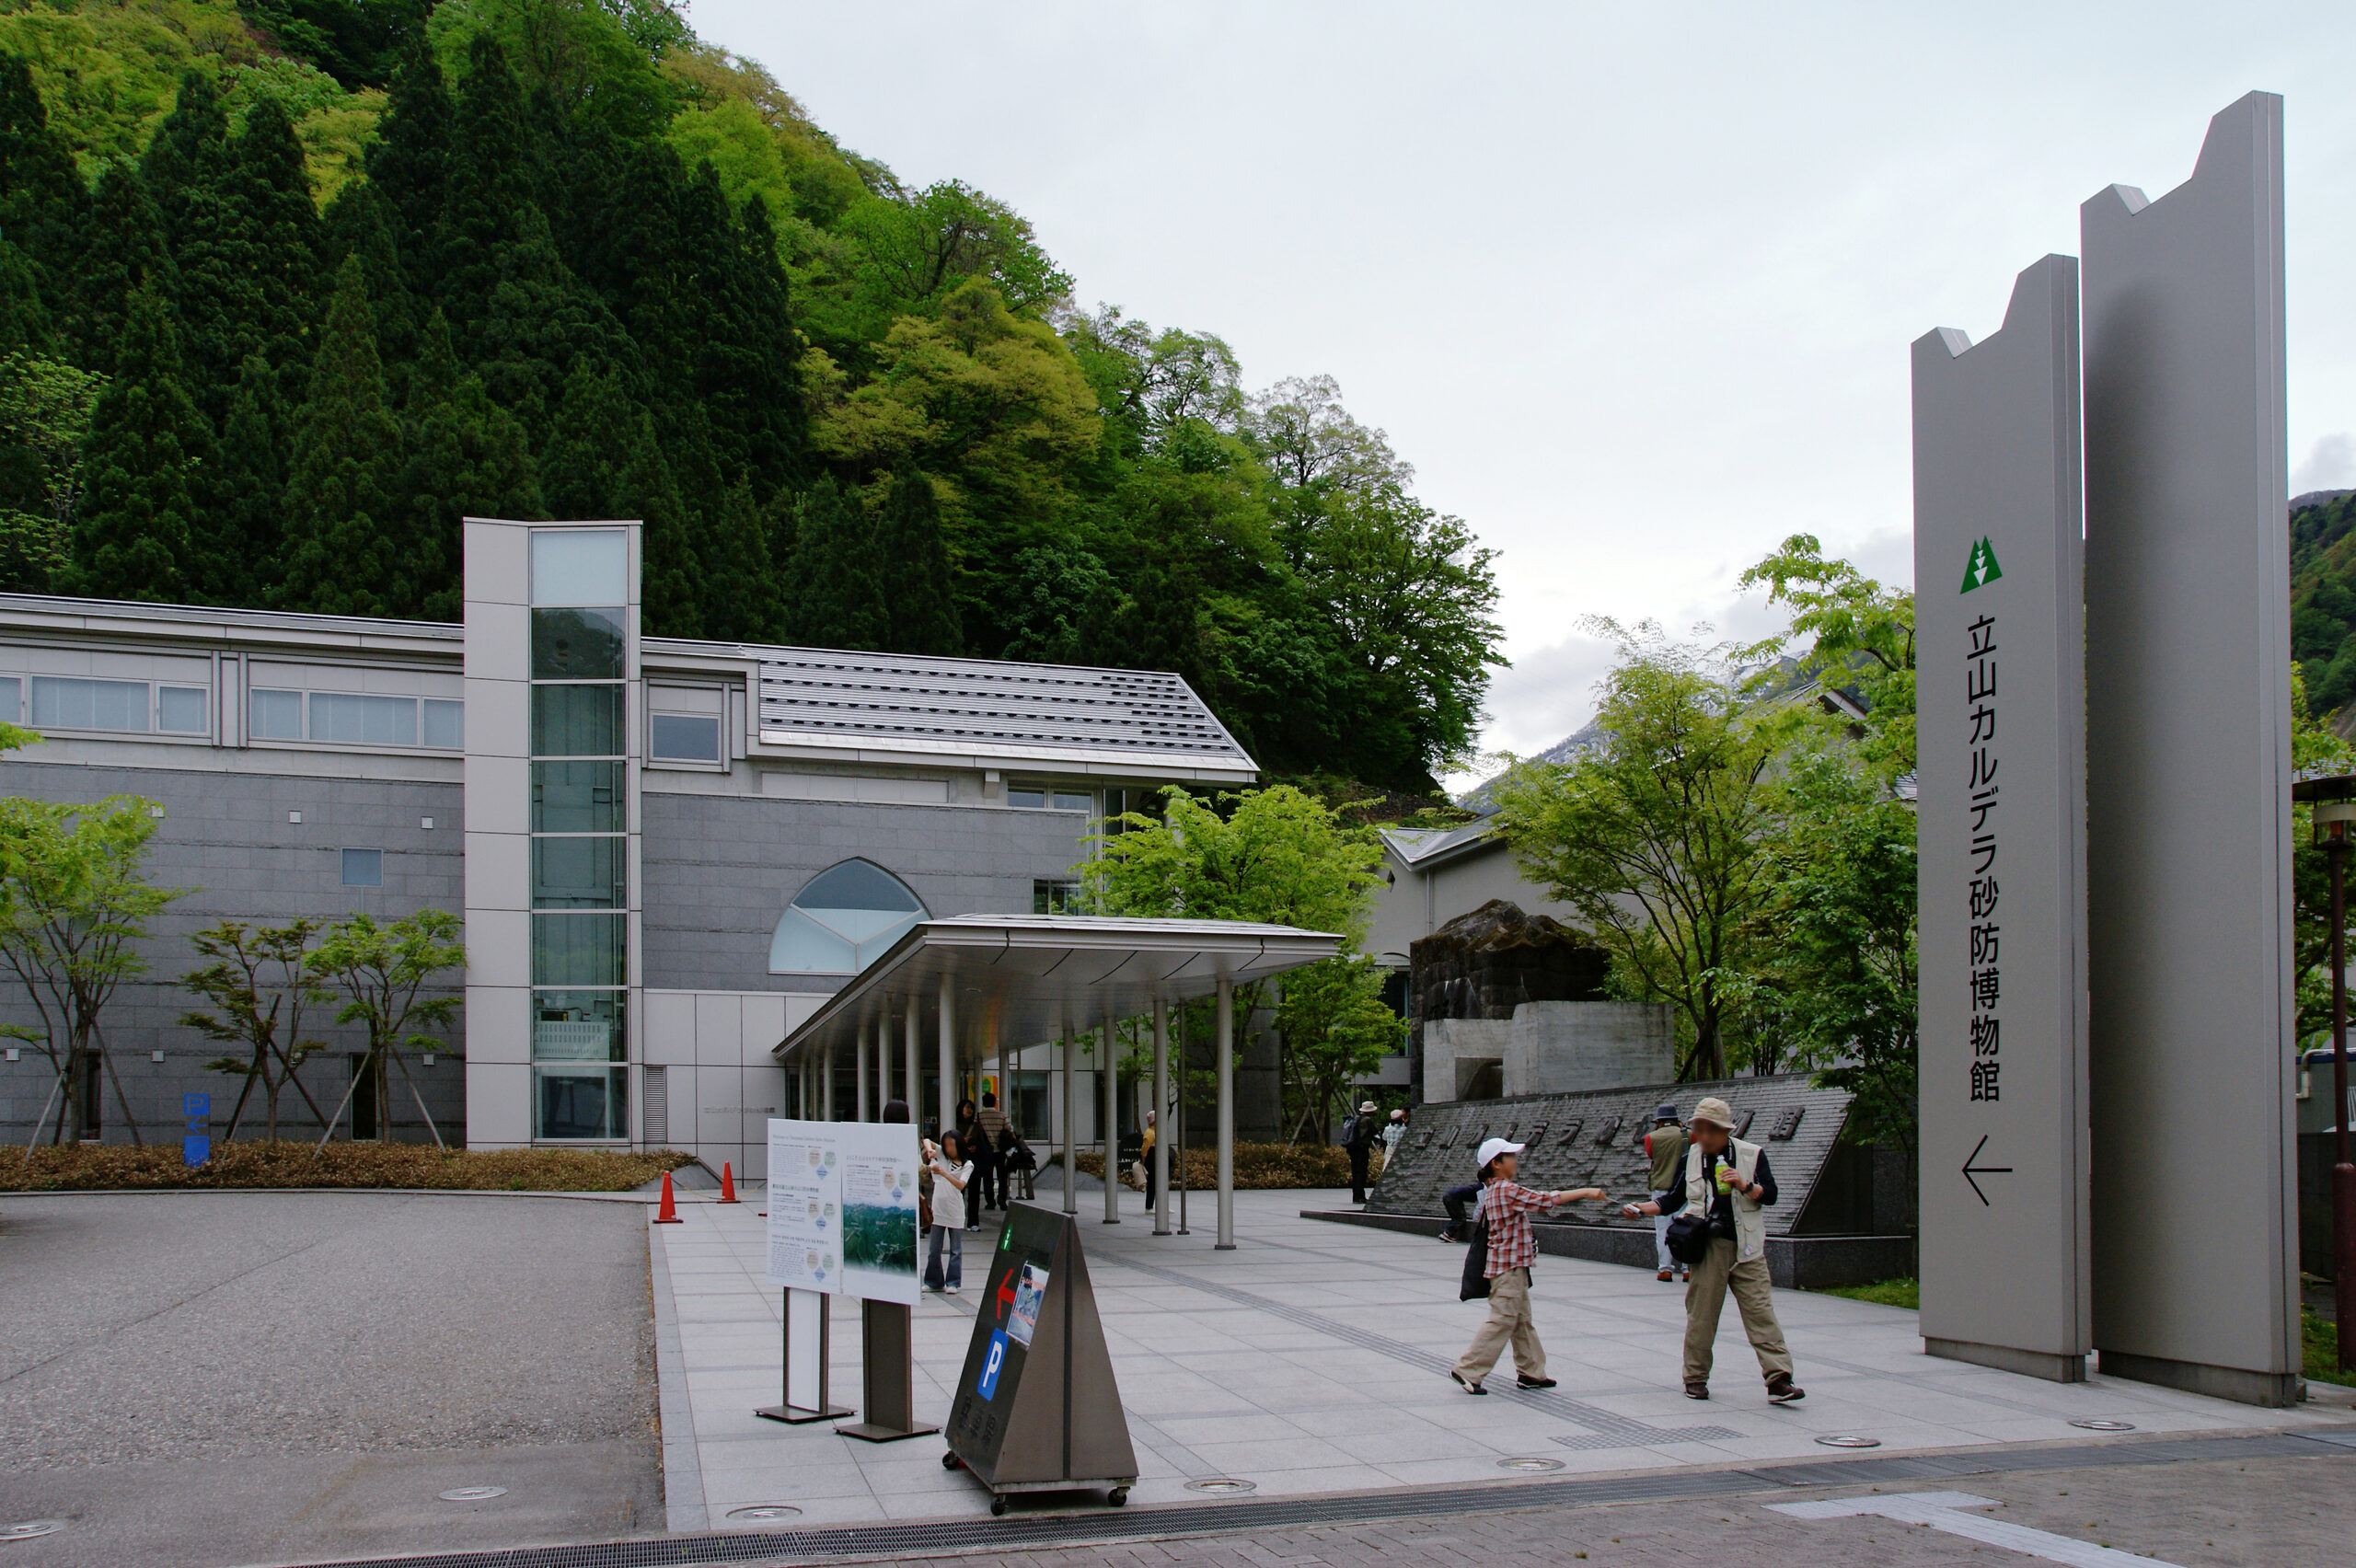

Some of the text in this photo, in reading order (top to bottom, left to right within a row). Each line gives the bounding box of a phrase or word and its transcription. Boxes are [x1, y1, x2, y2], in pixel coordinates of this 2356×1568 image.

[1967, 614, 2001, 1102] 立山カルデラ砂防博物館
[188, 1096, 204, 1113] P
[982, 1340, 1003, 1388] P
